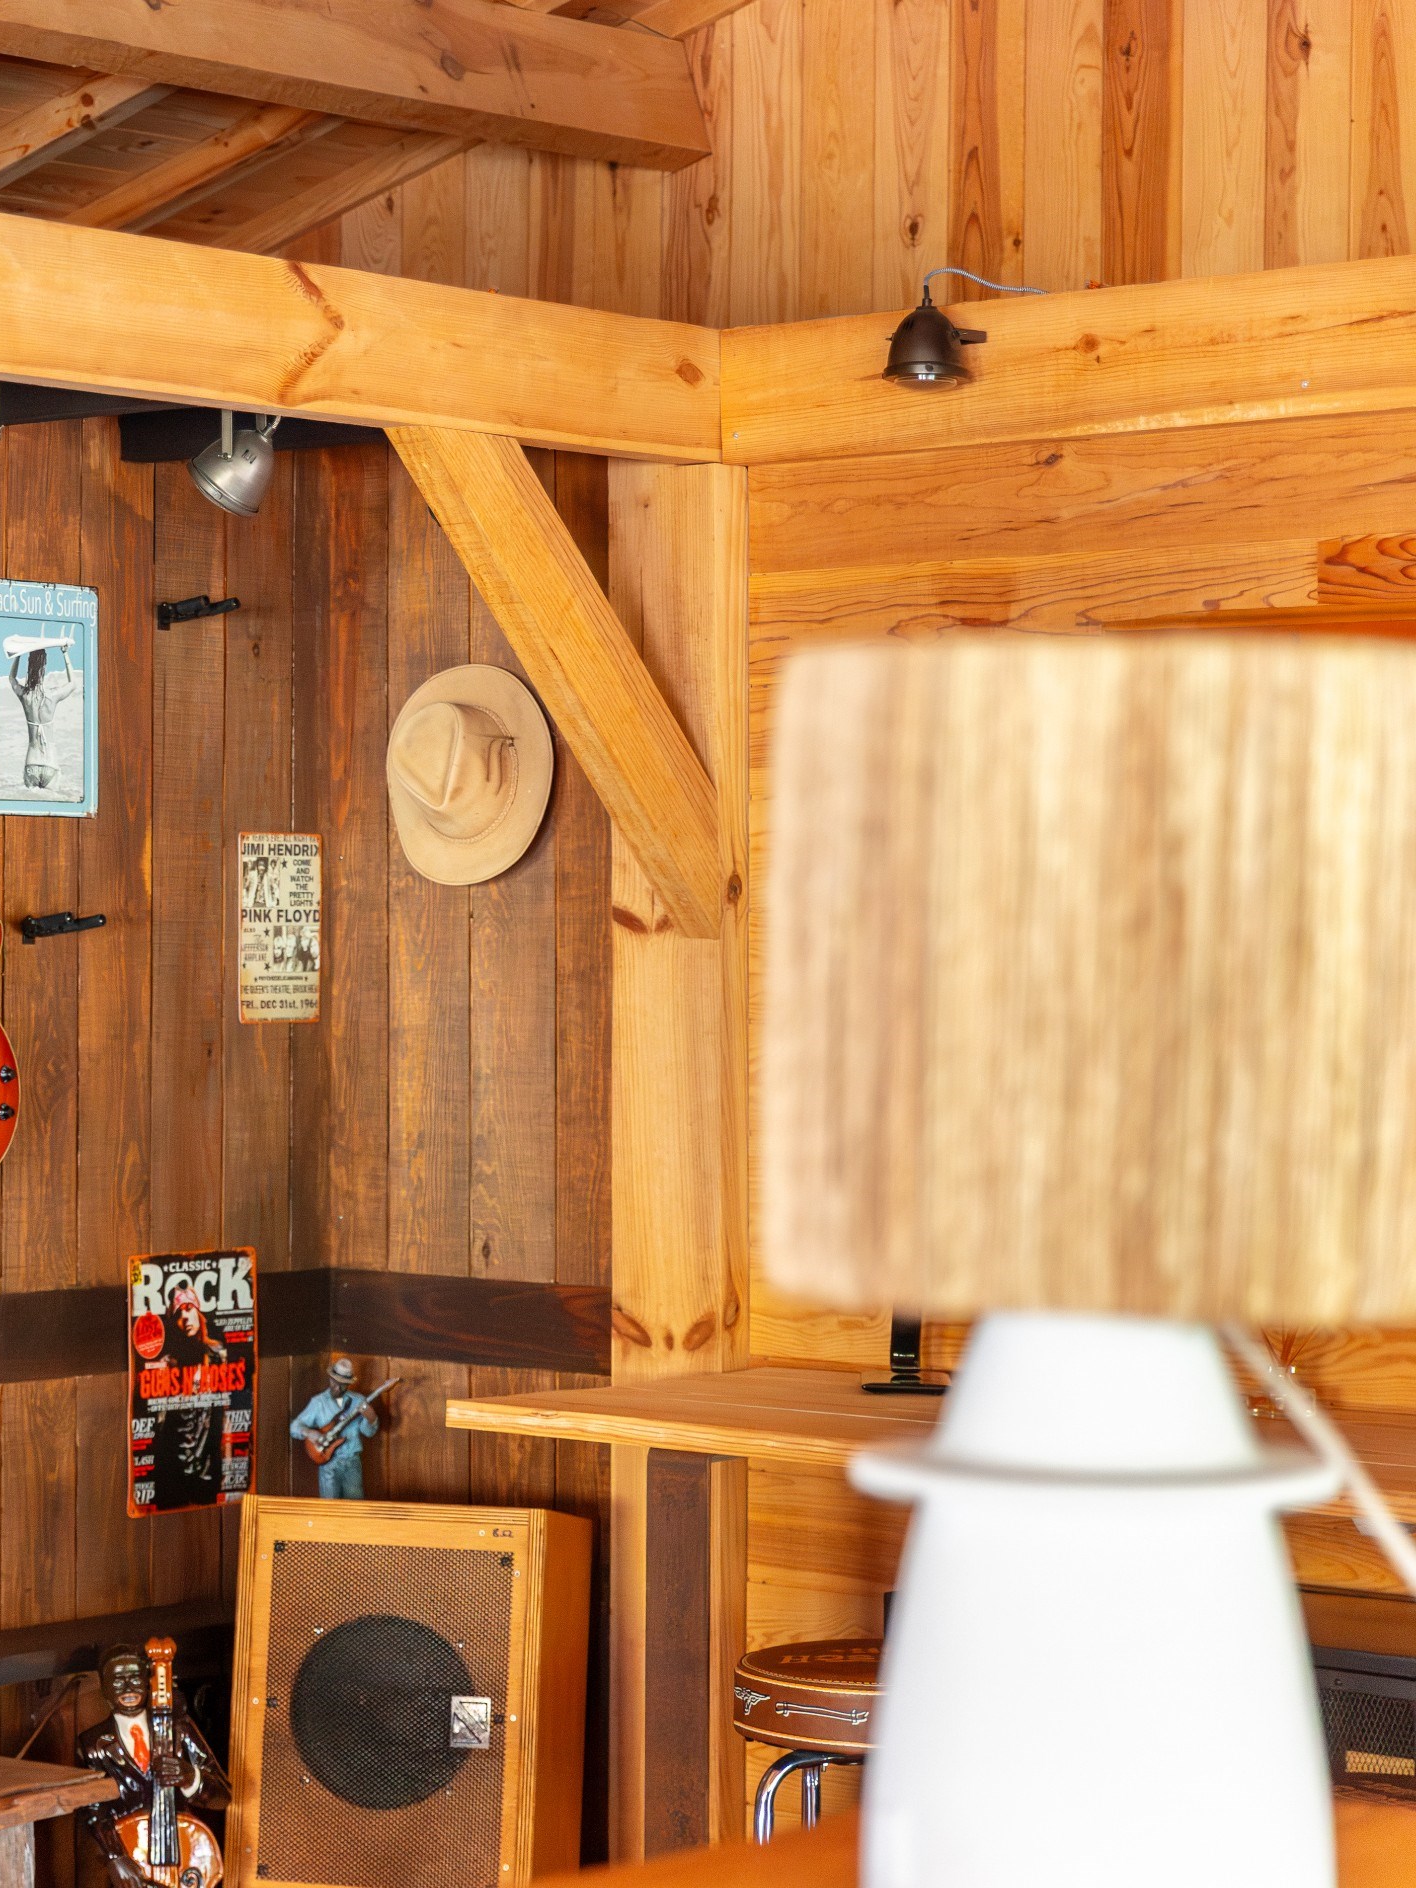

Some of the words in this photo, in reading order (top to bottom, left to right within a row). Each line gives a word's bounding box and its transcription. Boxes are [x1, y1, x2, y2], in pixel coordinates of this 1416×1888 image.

[19, 588, 42, 615] Sun
[44, 590, 54, 616] &
[56, 591, 98, 627] Surfing
[241, 843, 264, 856] JIMI
[293, 859, 312, 867] COME
[290, 875, 314, 883] WATCH
[289, 891, 315, 899] PRETTY
[289, 899, 313, 907] LIGHTS
[241, 908, 272, 923] PINK
[276, 909, 320, 923] FLOYD
[260, 1000, 278, 1009] DEC
[169, 1260, 212, 1272] CLASSIC
[132, 1256, 254, 1317] ROCK
[139, 1366, 181, 1400] GUNS
[132, 1416, 156, 1434] DEF
[134, 1454, 155, 1467] LASH
